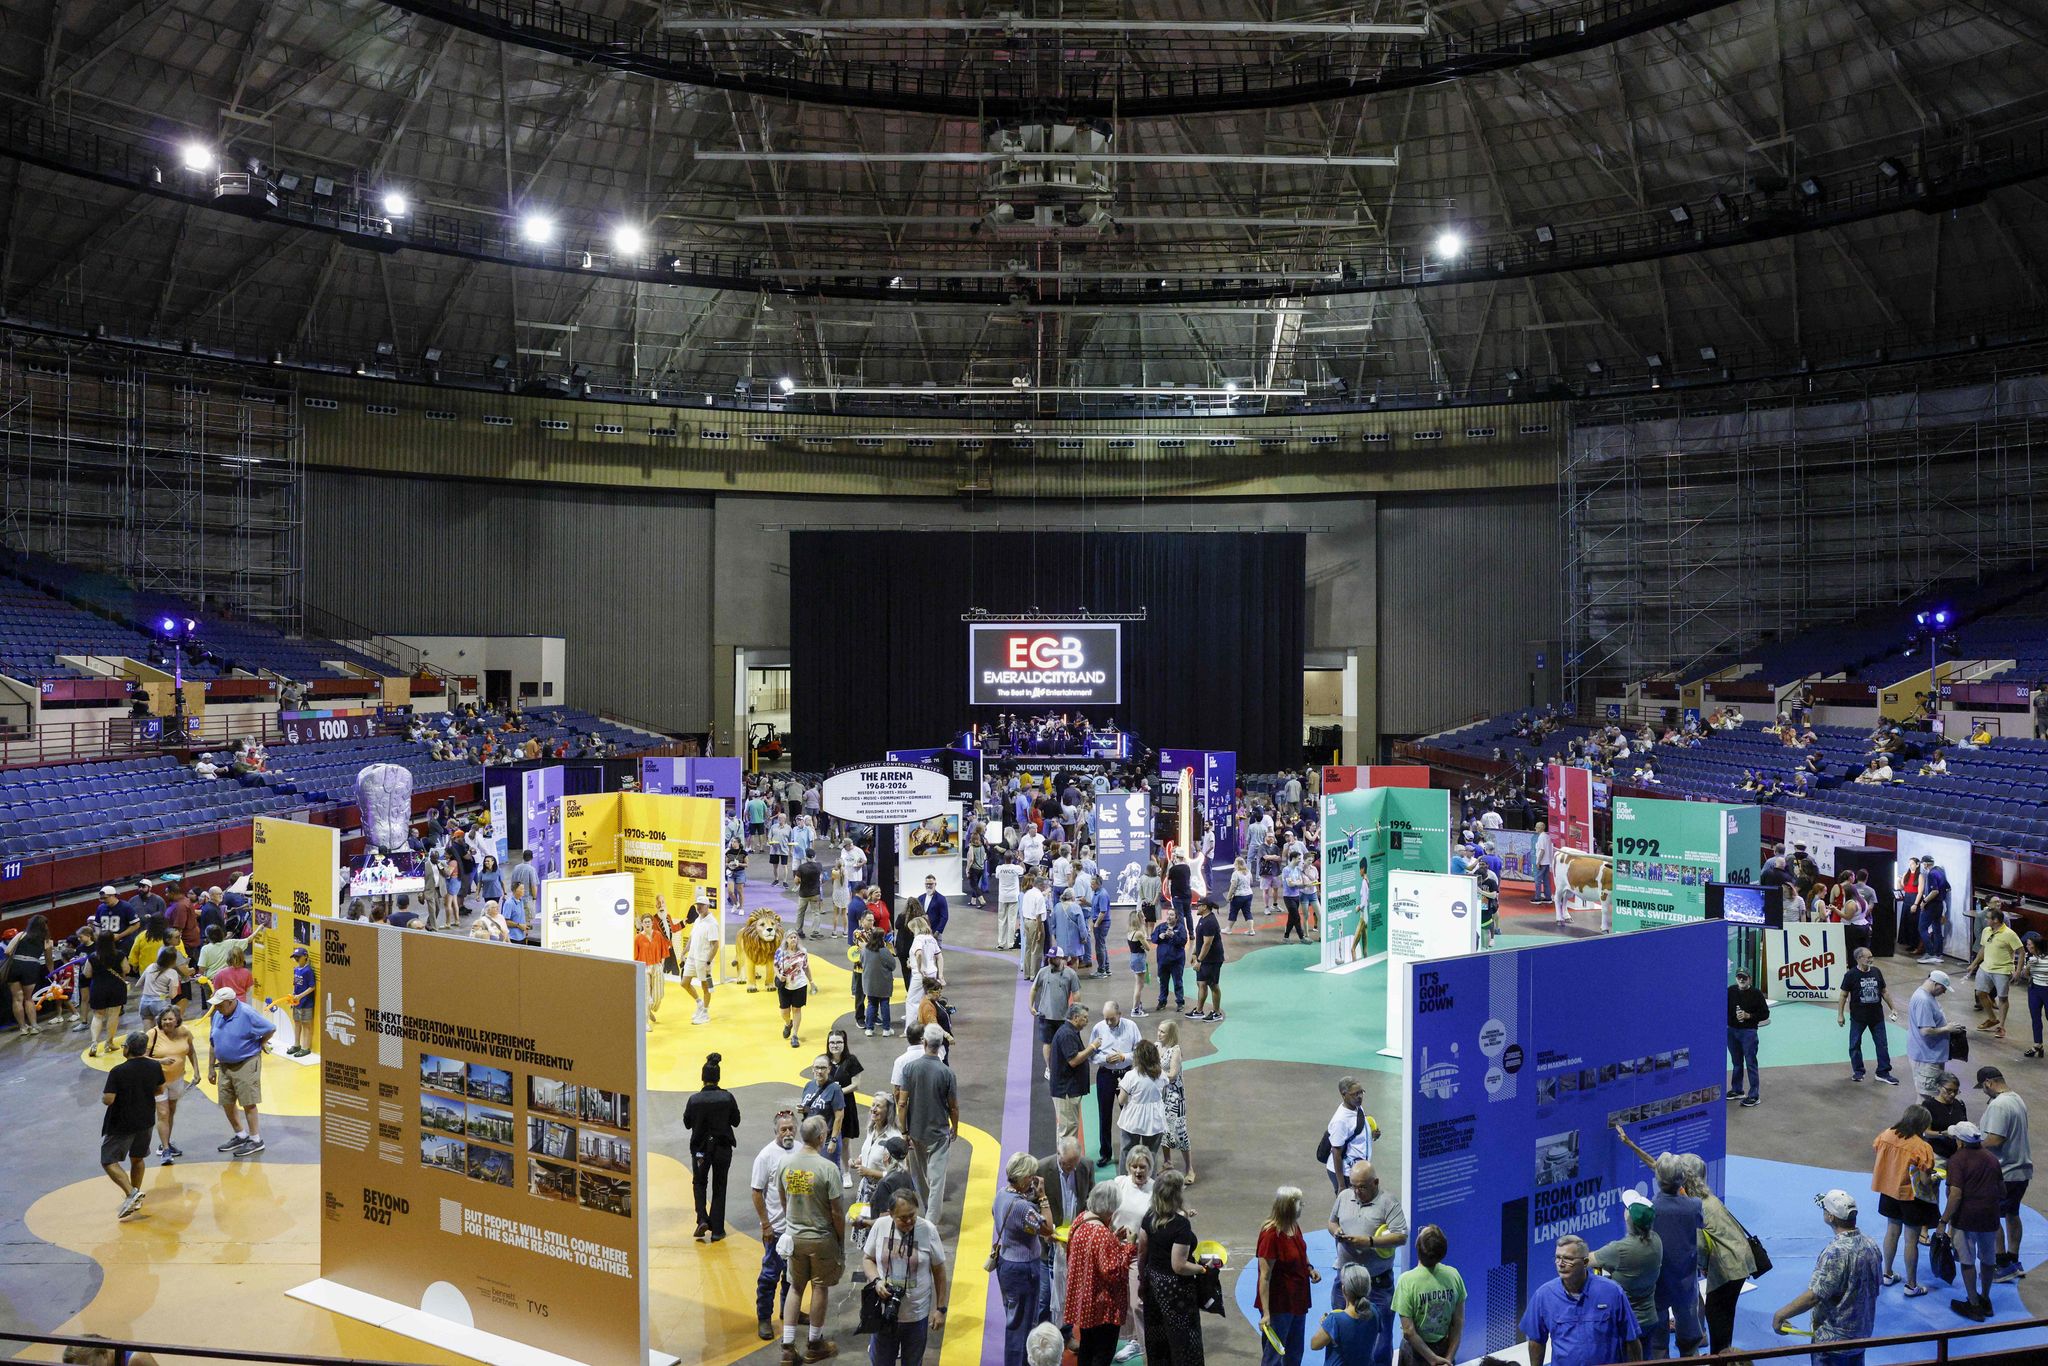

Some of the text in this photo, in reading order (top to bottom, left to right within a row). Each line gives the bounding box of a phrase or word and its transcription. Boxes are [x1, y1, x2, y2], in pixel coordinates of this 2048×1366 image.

[1010, 637, 1084, 668] ECB
[984, 672, 1105, 684] EMERALDCITYBAND
[42, 684, 53, 693] 317
[126, 683, 135, 692] 31
[1941, 686, 1951, 694] 303
[2017, 688, 2029, 696] 303
[149, 722, 159, 731] 211
[190, 719, 199, 728] 212
[319, 720, 348, 740] FOOD
[920, 764, 940, 773] CENTER
[860, 772, 913, 781] THE ARENA
[1162, 783, 1180, 794] 197
[1390, 820, 1411, 830] 1996
[1616, 837, 1660, 857] 1992
[568, 858, 588, 869] 1978
[624, 856, 673, 868] UNDER THE DOME
[4, 862, 21, 878] 111
[1728, 868, 1750, 884] 1968
[254, 893, 272, 907] 1990s
[1616, 898, 1674, 912] THE DAVIS CUP
[294, 902, 310, 917] 2009
[1616, 907, 1705, 923] USA VS. SWITZERLAND
[325, 928, 340, 941] IT'S
[325, 941, 347, 954] GOIN'
[325, 952, 351, 967] DOWN
[1778, 952, 1835, 981] ARENA
[1420, 972, 1439, 986] IT'S
[1420, 984, 1449, 1000] GOIN'
[1786, 990, 1828, 999] FOOTBALL
[1420, 996, 1454, 1013] DOWN
[365, 1008, 536, 1051] THE NEXT GENERATION WILL EXPERIENCE
[365, 1019, 574, 1072] THIS CORNER OF DOWNTOWN VERY DIFFERENTLY
[1535, 1176, 1603, 1209] FROM CITY
[364, 1188, 410, 1214] BEYOND
[1535, 1186, 1626, 1226] BLOCK TO CITY
[364, 1204, 392, 1225] 2027
[1534, 1208, 1610, 1244] LANDMARK.
[464, 1208, 628, 1264] BUT PEOPLE WILL STILL COME HERE
[464, 1221, 632, 1279] FOR THE SAME REASON: TO GATHER.
[492, 1287, 516, 1300] bennett
[492, 1296, 518, 1310] partners
[526, 1299, 549, 1318] TVS
